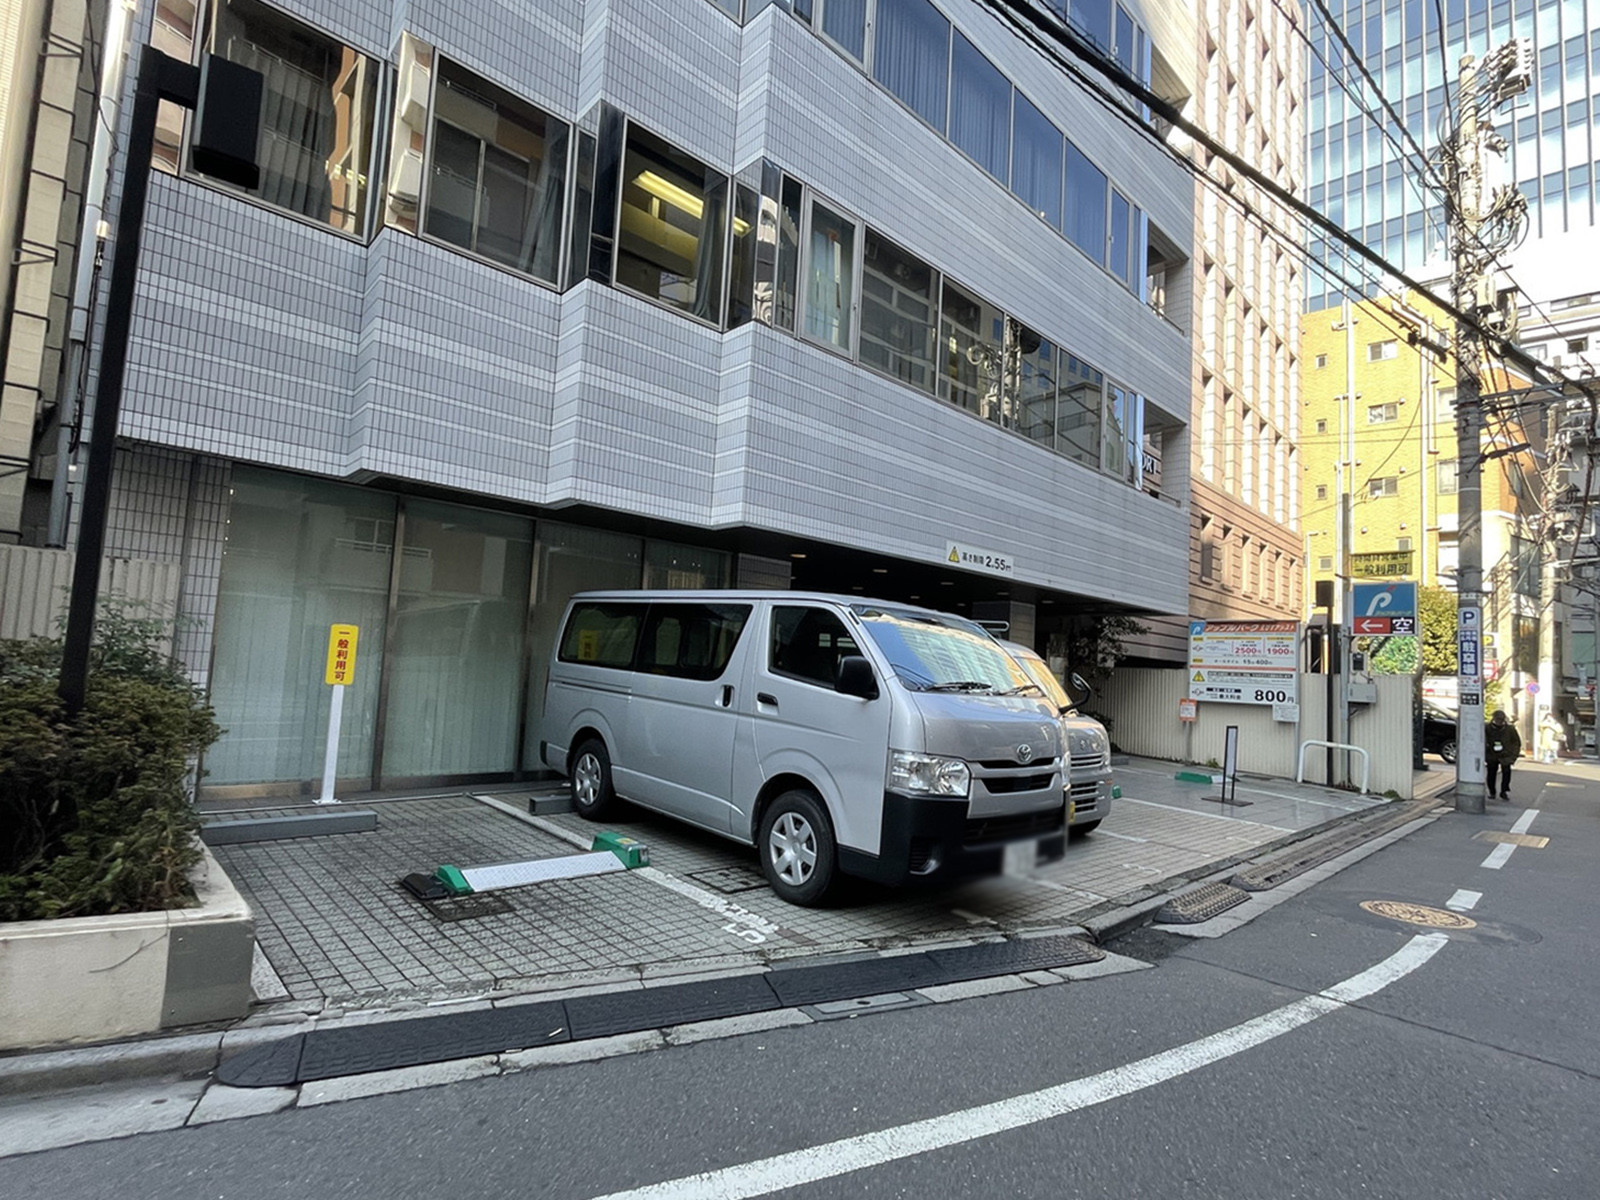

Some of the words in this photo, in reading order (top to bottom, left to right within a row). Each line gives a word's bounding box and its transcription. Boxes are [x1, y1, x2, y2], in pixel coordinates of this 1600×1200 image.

[1354, 563, 1408, 575] 一般利用可
[1463, 611, 1475, 624] P
[1205, 624, 1259, 632] アップルパーク
[1392, 617, 1413, 634] 空
[335, 631, 350, 681] 一般利用可
